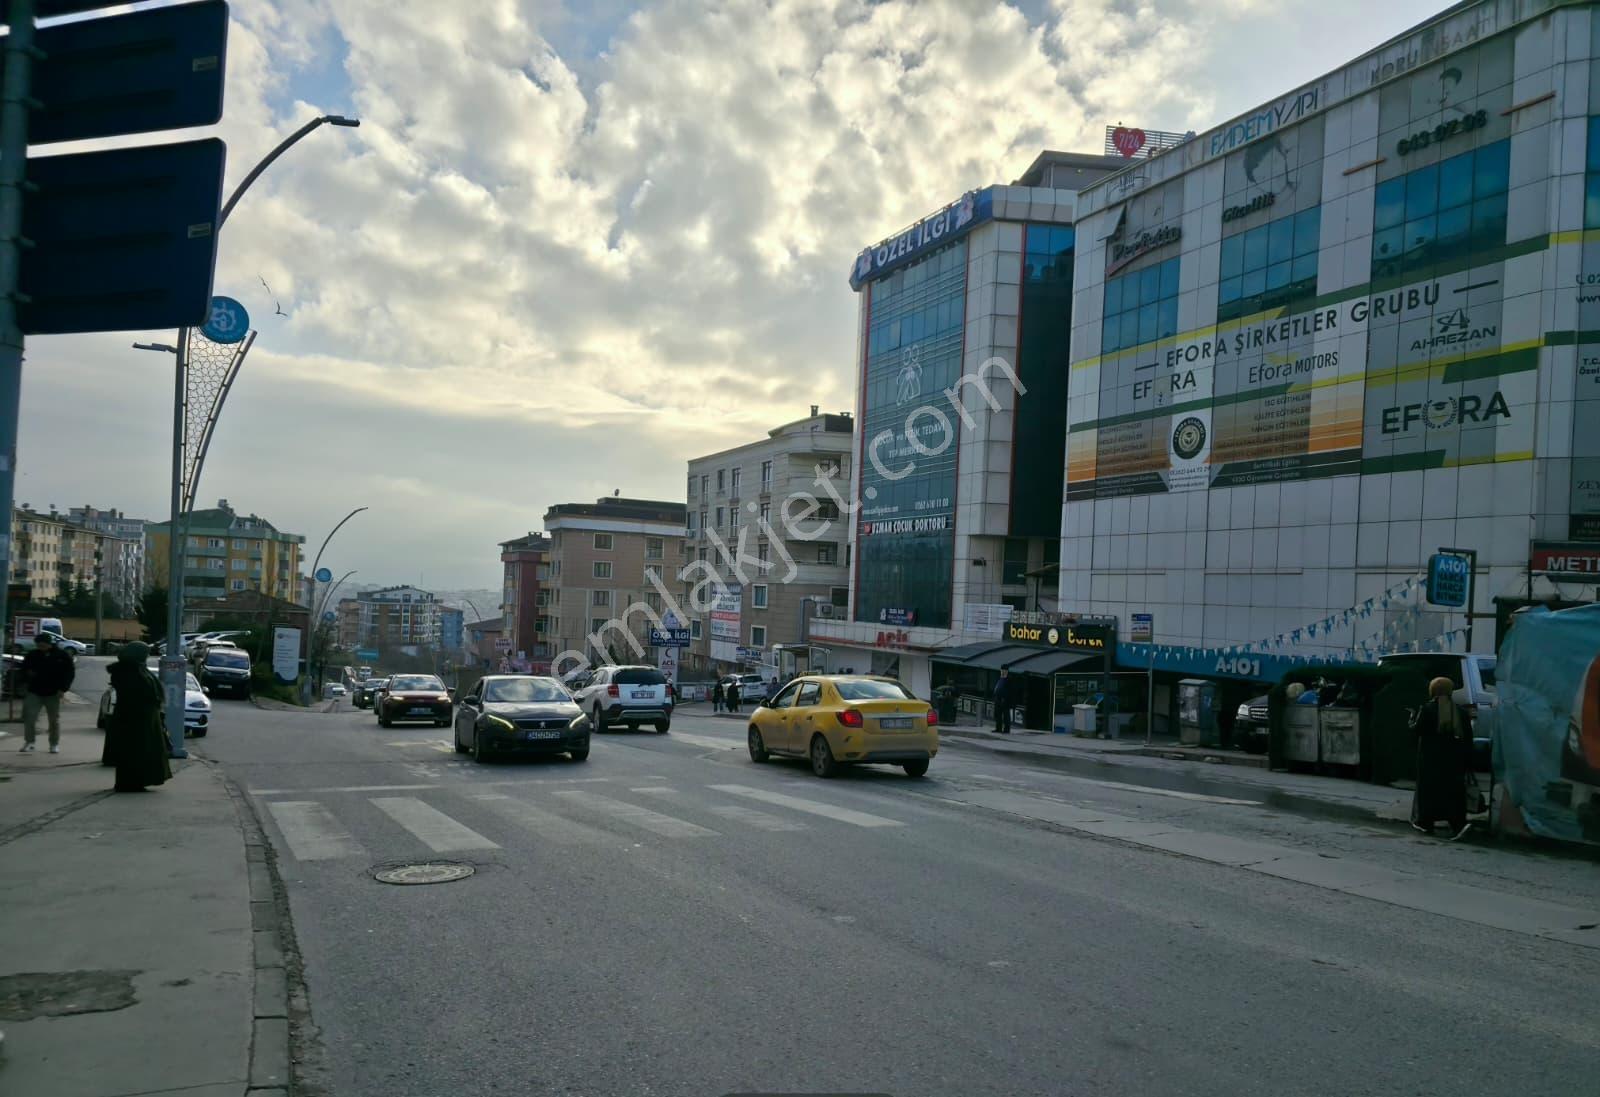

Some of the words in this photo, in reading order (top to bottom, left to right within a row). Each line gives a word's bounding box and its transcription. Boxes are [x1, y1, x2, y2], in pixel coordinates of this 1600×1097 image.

[1119, 133, 1141, 149] 7/24
[1166, 339, 1228, 369] EFORA
[1234, 309, 1338, 355] ŞİRKETLER
[1350, 282, 1440, 323] GRUBU
[1249, 362, 1293, 385] Efora
[1294, 352, 1339, 375] MOTORS
[1010, 624, 1043, 641] bahar
